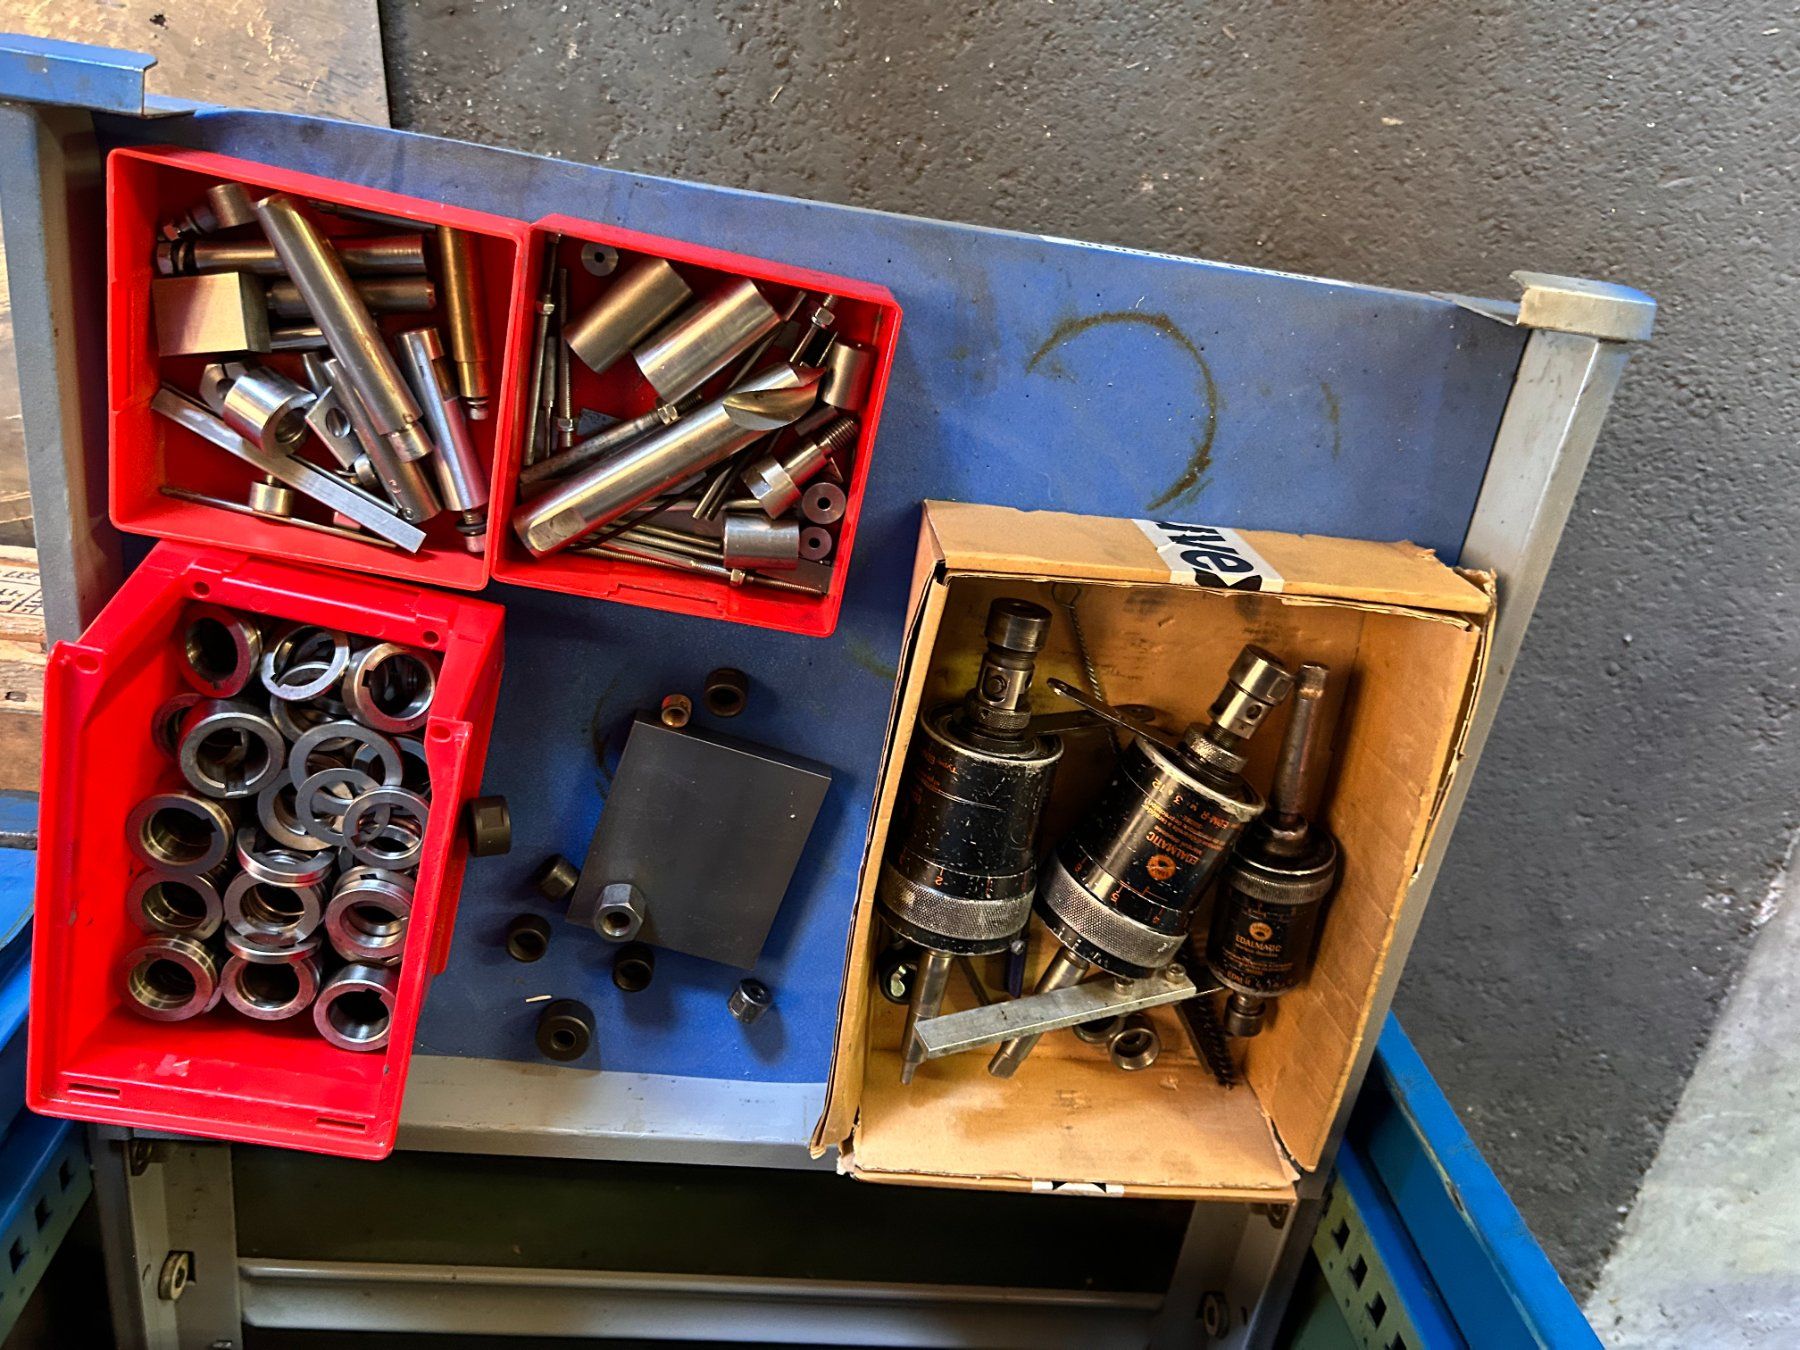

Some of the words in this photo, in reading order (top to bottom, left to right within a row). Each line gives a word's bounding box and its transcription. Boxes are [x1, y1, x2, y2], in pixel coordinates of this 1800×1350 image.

[1145, 831, 1199, 865] EDALMATIC
[934, 875, 943, 885] 2
[1110, 892, 1120, 902] 5
